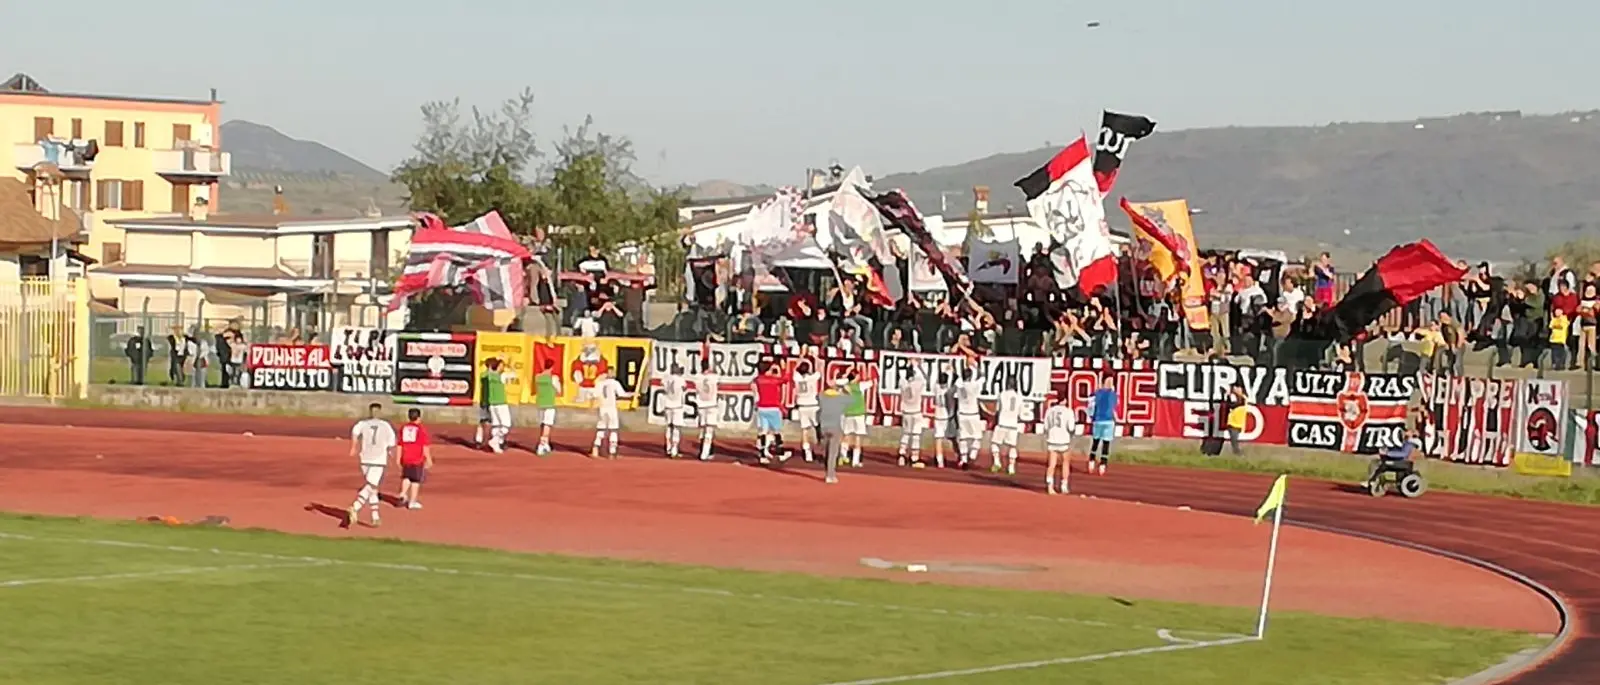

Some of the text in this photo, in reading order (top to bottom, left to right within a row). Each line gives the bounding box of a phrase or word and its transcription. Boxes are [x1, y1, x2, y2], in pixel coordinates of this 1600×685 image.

[252, 346, 332, 367] DONNE AL
[253, 367, 330, 388] SEGUITO
[1160, 363, 1290, 406] CURVA
[368, 424, 379, 445] 7
